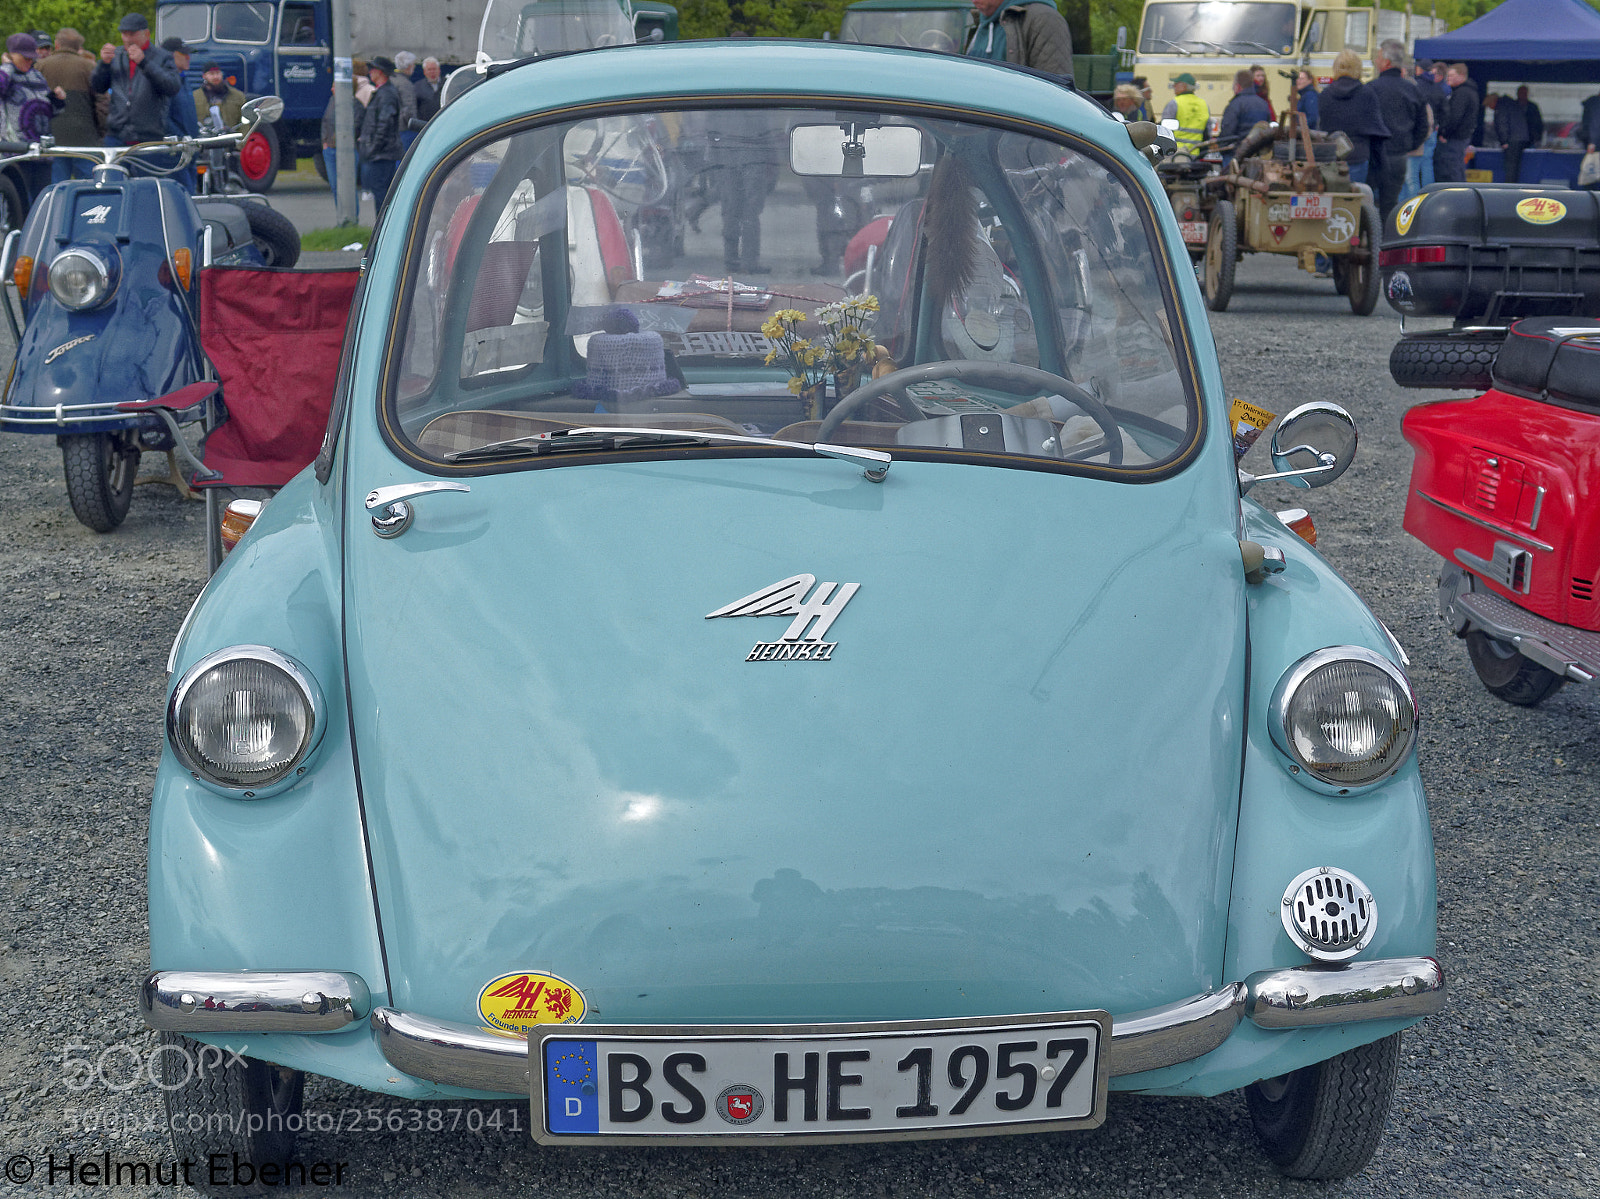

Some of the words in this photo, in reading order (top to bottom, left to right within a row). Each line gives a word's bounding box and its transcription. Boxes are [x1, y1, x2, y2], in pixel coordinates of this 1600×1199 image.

[1305, 196, 1320, 207] MD
[1294, 207, 1328, 217] 07003
[1233, 400, 1243, 408] 17.
[1240, 412, 1256, 422] Das
[745, 642, 838, 662] HEINKEL
[501, 1009, 540, 1020] HEINKEL
[487, 1012, 520, 1032] Freunde
[607, 1051, 707, 1124] BS
[773, 1050, 871, 1121] HE
[895, 1037, 1089, 1119] 1957
[564, 1097, 583, 1117] D
